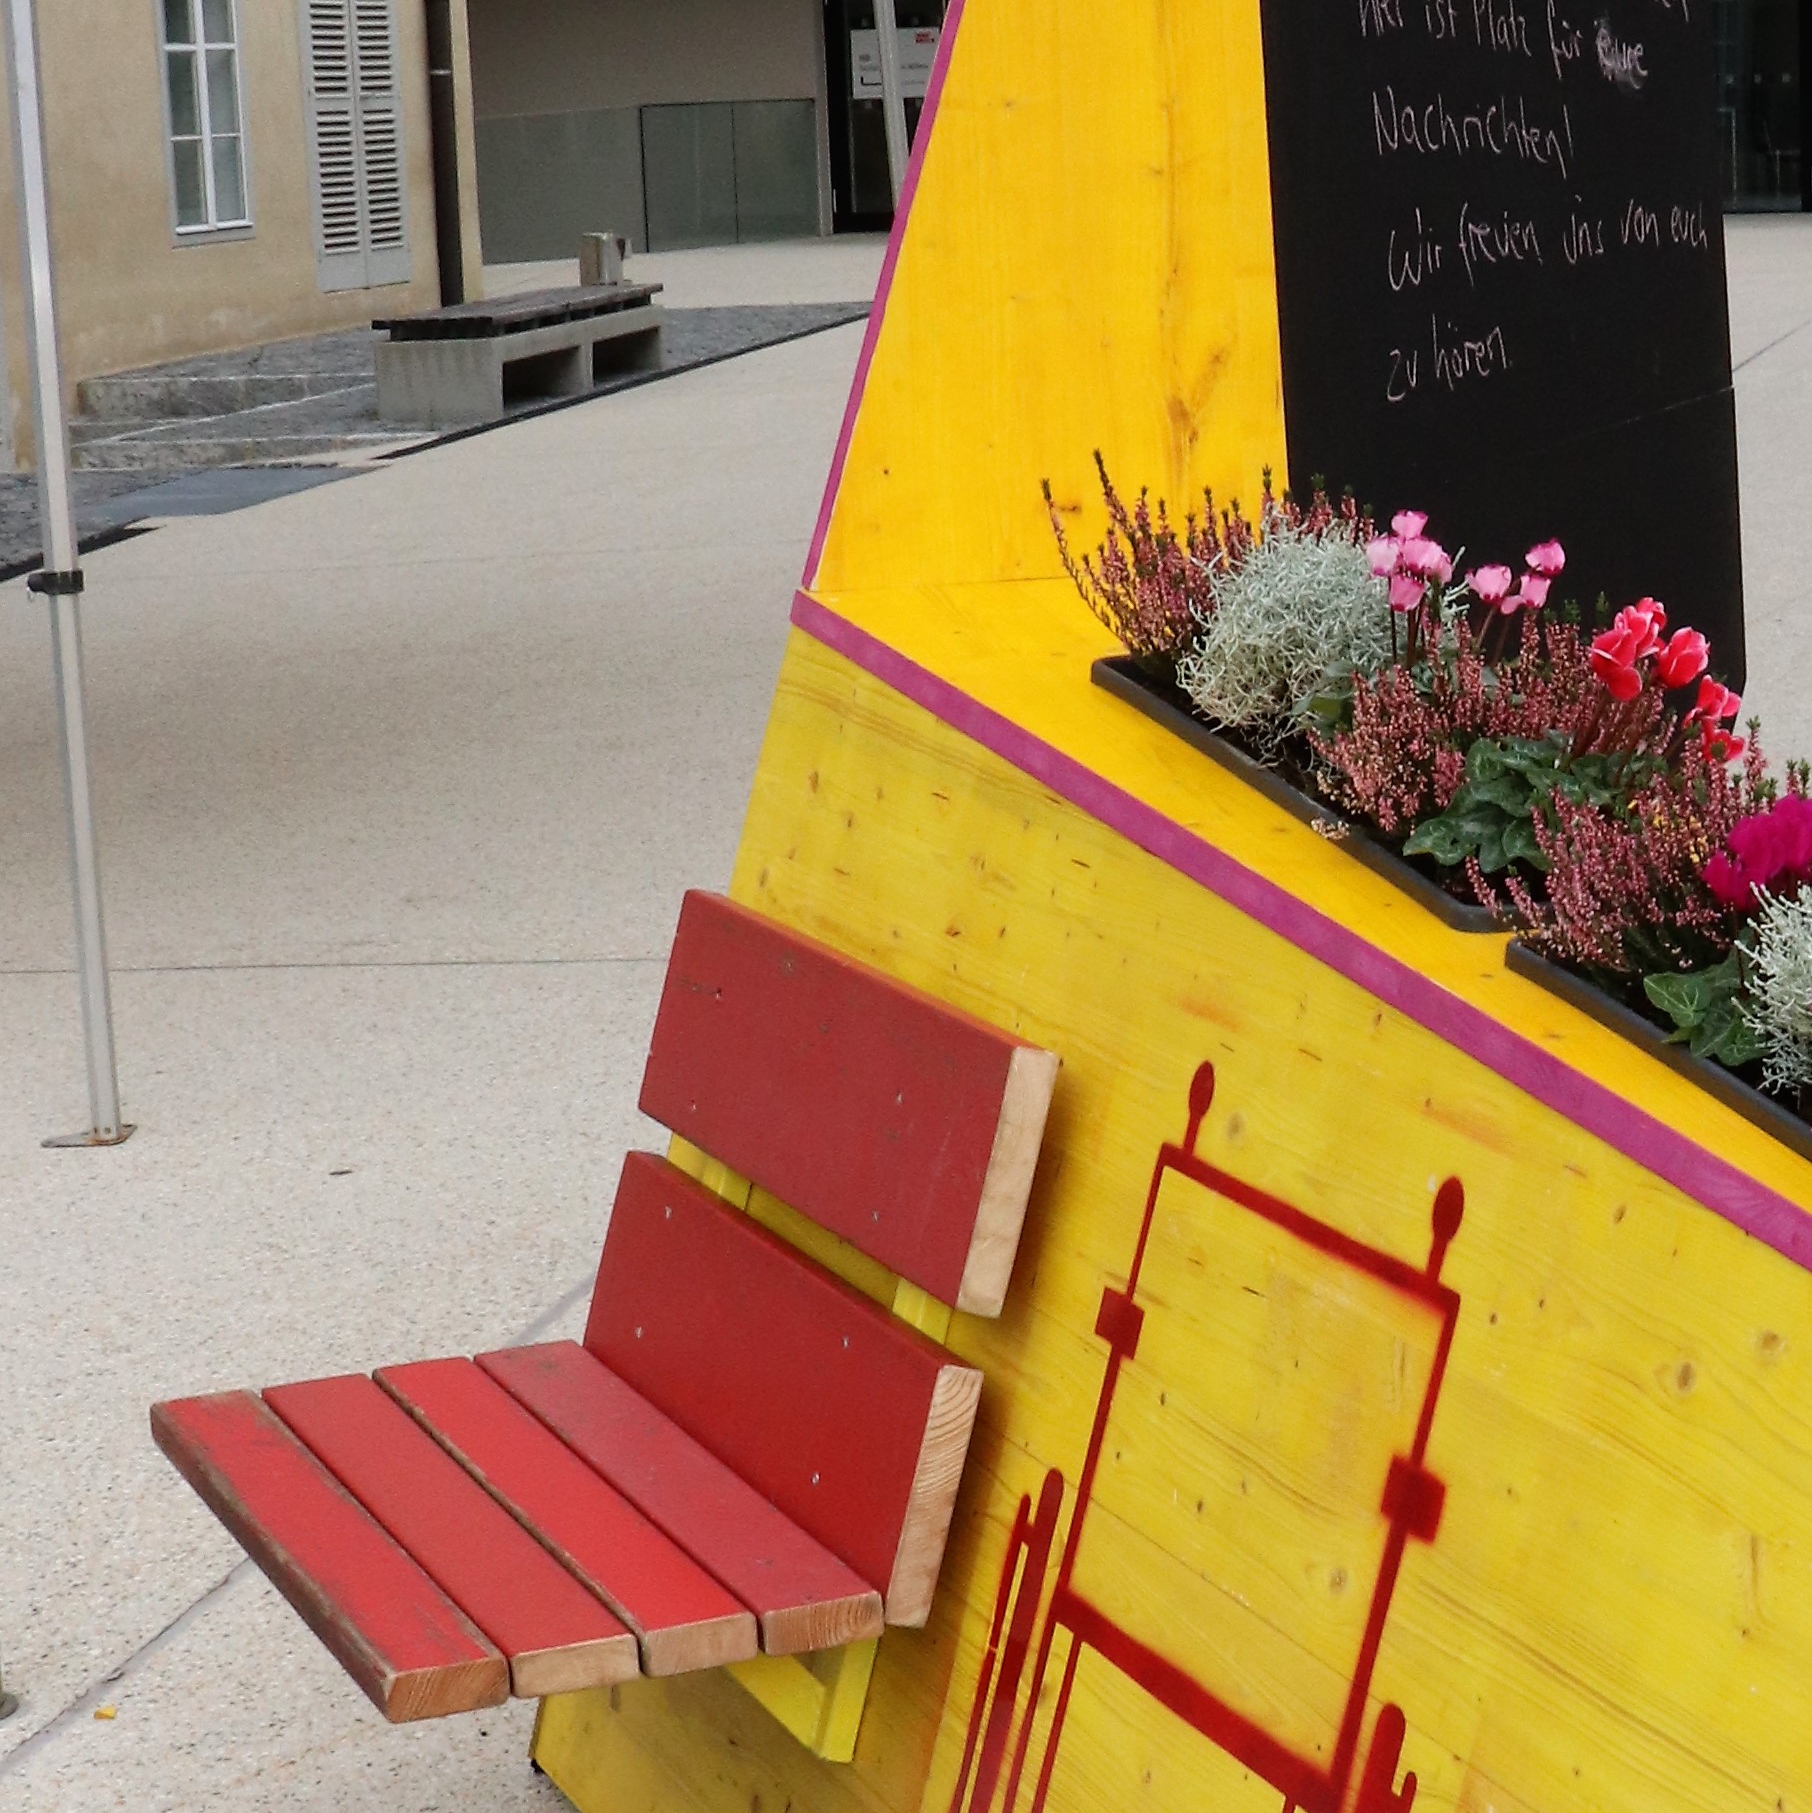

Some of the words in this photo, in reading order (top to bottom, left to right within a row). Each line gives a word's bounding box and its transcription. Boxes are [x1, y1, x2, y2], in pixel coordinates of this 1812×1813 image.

[1372, 85, 1575, 179] Nachrichten!
[1388, 207, 1443, 291] Wir
[1458, 202, 1544, 288] freuen
[1563, 195, 1605, 266] uns
[1620, 198, 1660, 248] von
[1669, 201, 1709, 250] euch
[1386, 348, 1419, 403] zu
